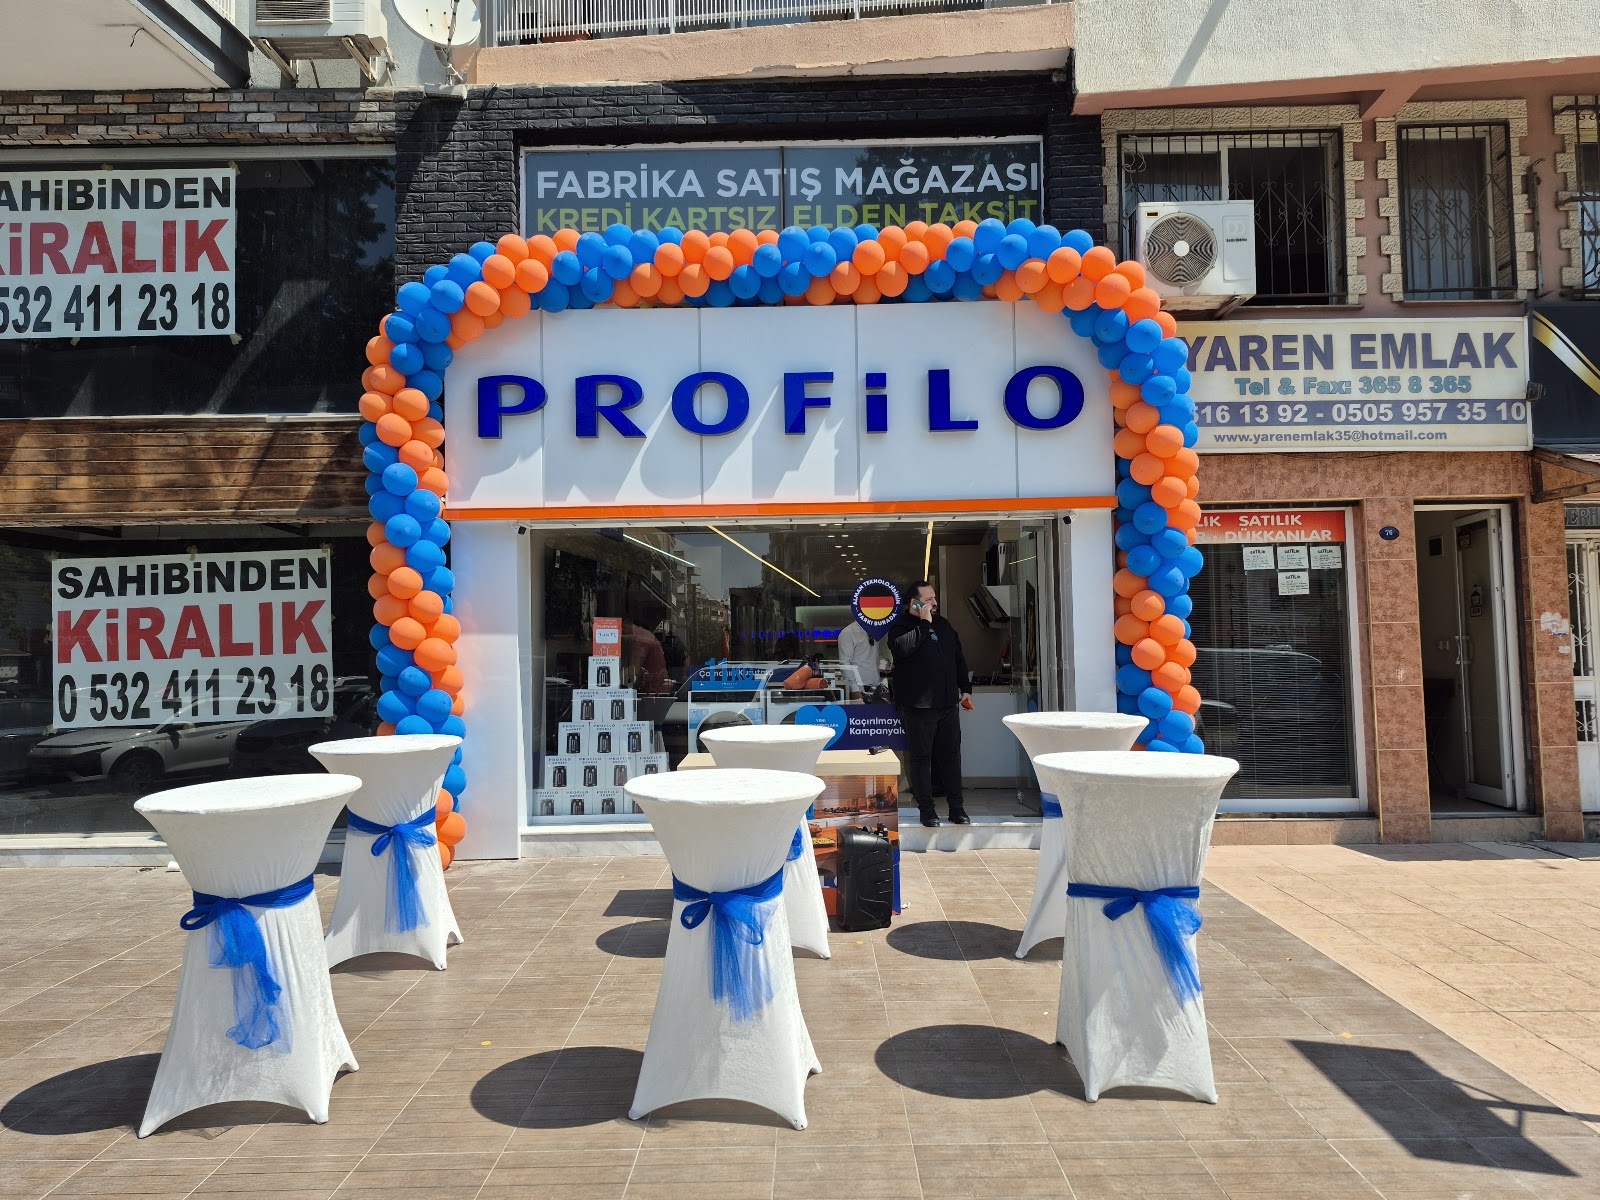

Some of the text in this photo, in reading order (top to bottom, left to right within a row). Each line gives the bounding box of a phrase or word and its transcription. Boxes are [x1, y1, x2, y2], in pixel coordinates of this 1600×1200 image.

[537, 158, 1038, 202] FABRİKA SATIŞ MAĞAZASI
[537, 194, 1038, 231] KREDİ KARTSIZ ELDEN TAKSİT
[0, 219, 230, 275] iRALIK
[64, 284, 122, 331] 411
[137, 283, 178, 331] 23
[191, 282, 230, 329] 18
[1180, 332, 1518, 372] YAREN EMLAK
[1234, 375, 1472, 396] Tel & Fax: 365 8 365
[1240, 404, 1269, 424] 13
[1277, 403, 1309, 423] 92
[1331, 402, 1394, 423] 0505
[1401, 402, 1448, 422] 957
[1456, 402, 1487, 421] 35
[1496, 402, 1526, 421] 10
[1214, 430, 1448, 444] www.yarenemlak35@hotmail.com
[1224, 528, 1332, 542] DÜKKANLAR
[1238, 514, 1303, 527] SATILIK
[853, 585, 865, 605] ALMAN
[58, 664, 329, 722] 0 532 411 23 18
